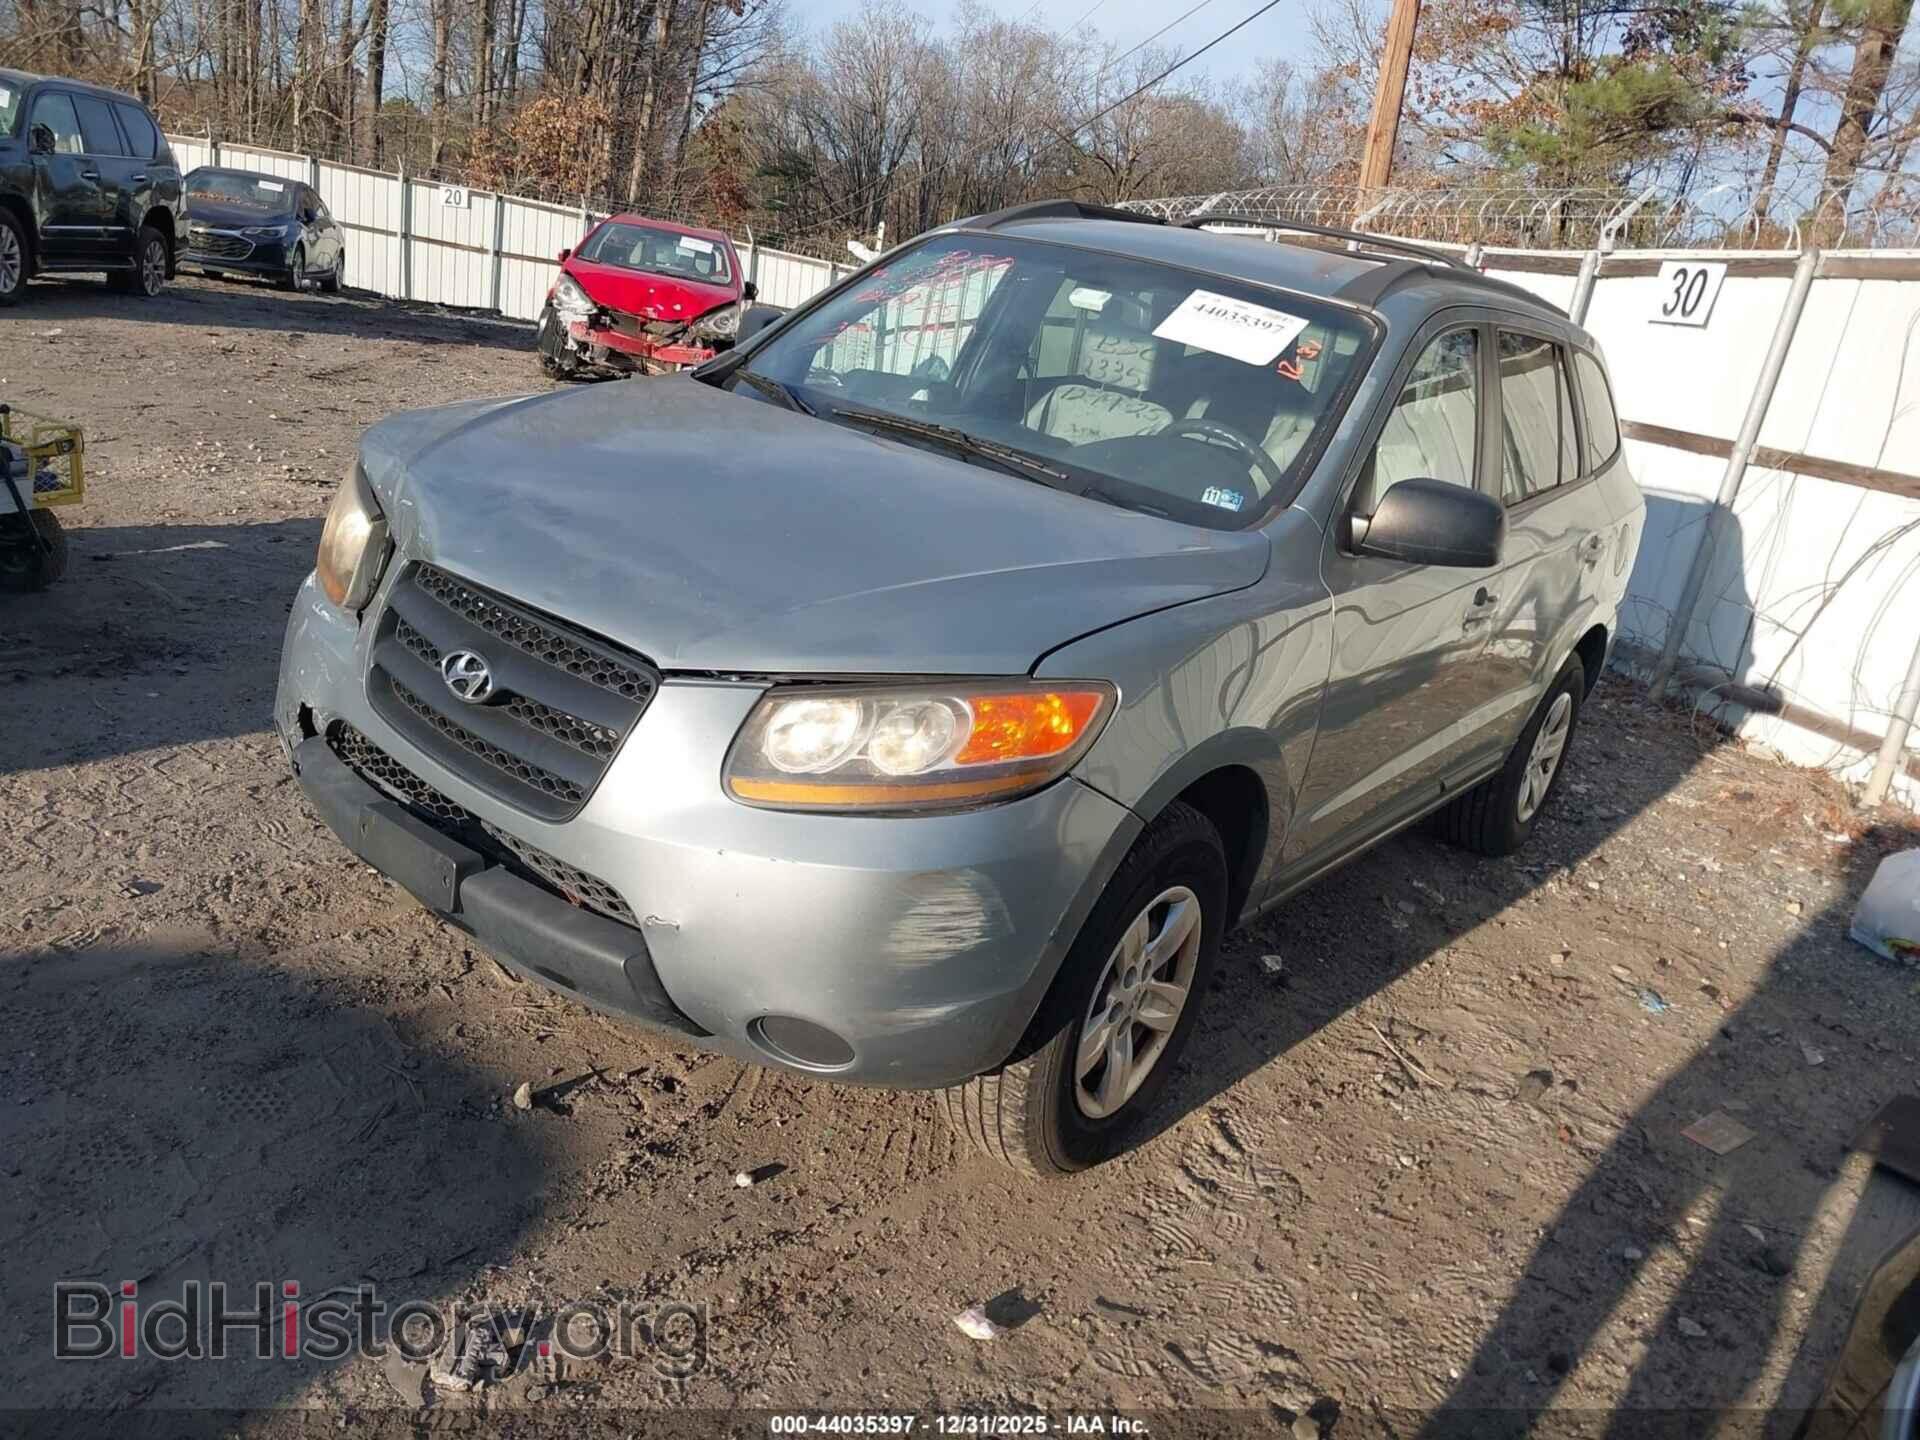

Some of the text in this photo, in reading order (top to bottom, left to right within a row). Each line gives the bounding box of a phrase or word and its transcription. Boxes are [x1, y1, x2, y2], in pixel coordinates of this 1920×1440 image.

[445, 189, 461, 205] 20
[1663, 268, 1708, 317] 30
[1193, 302, 1285, 333] 44035397
